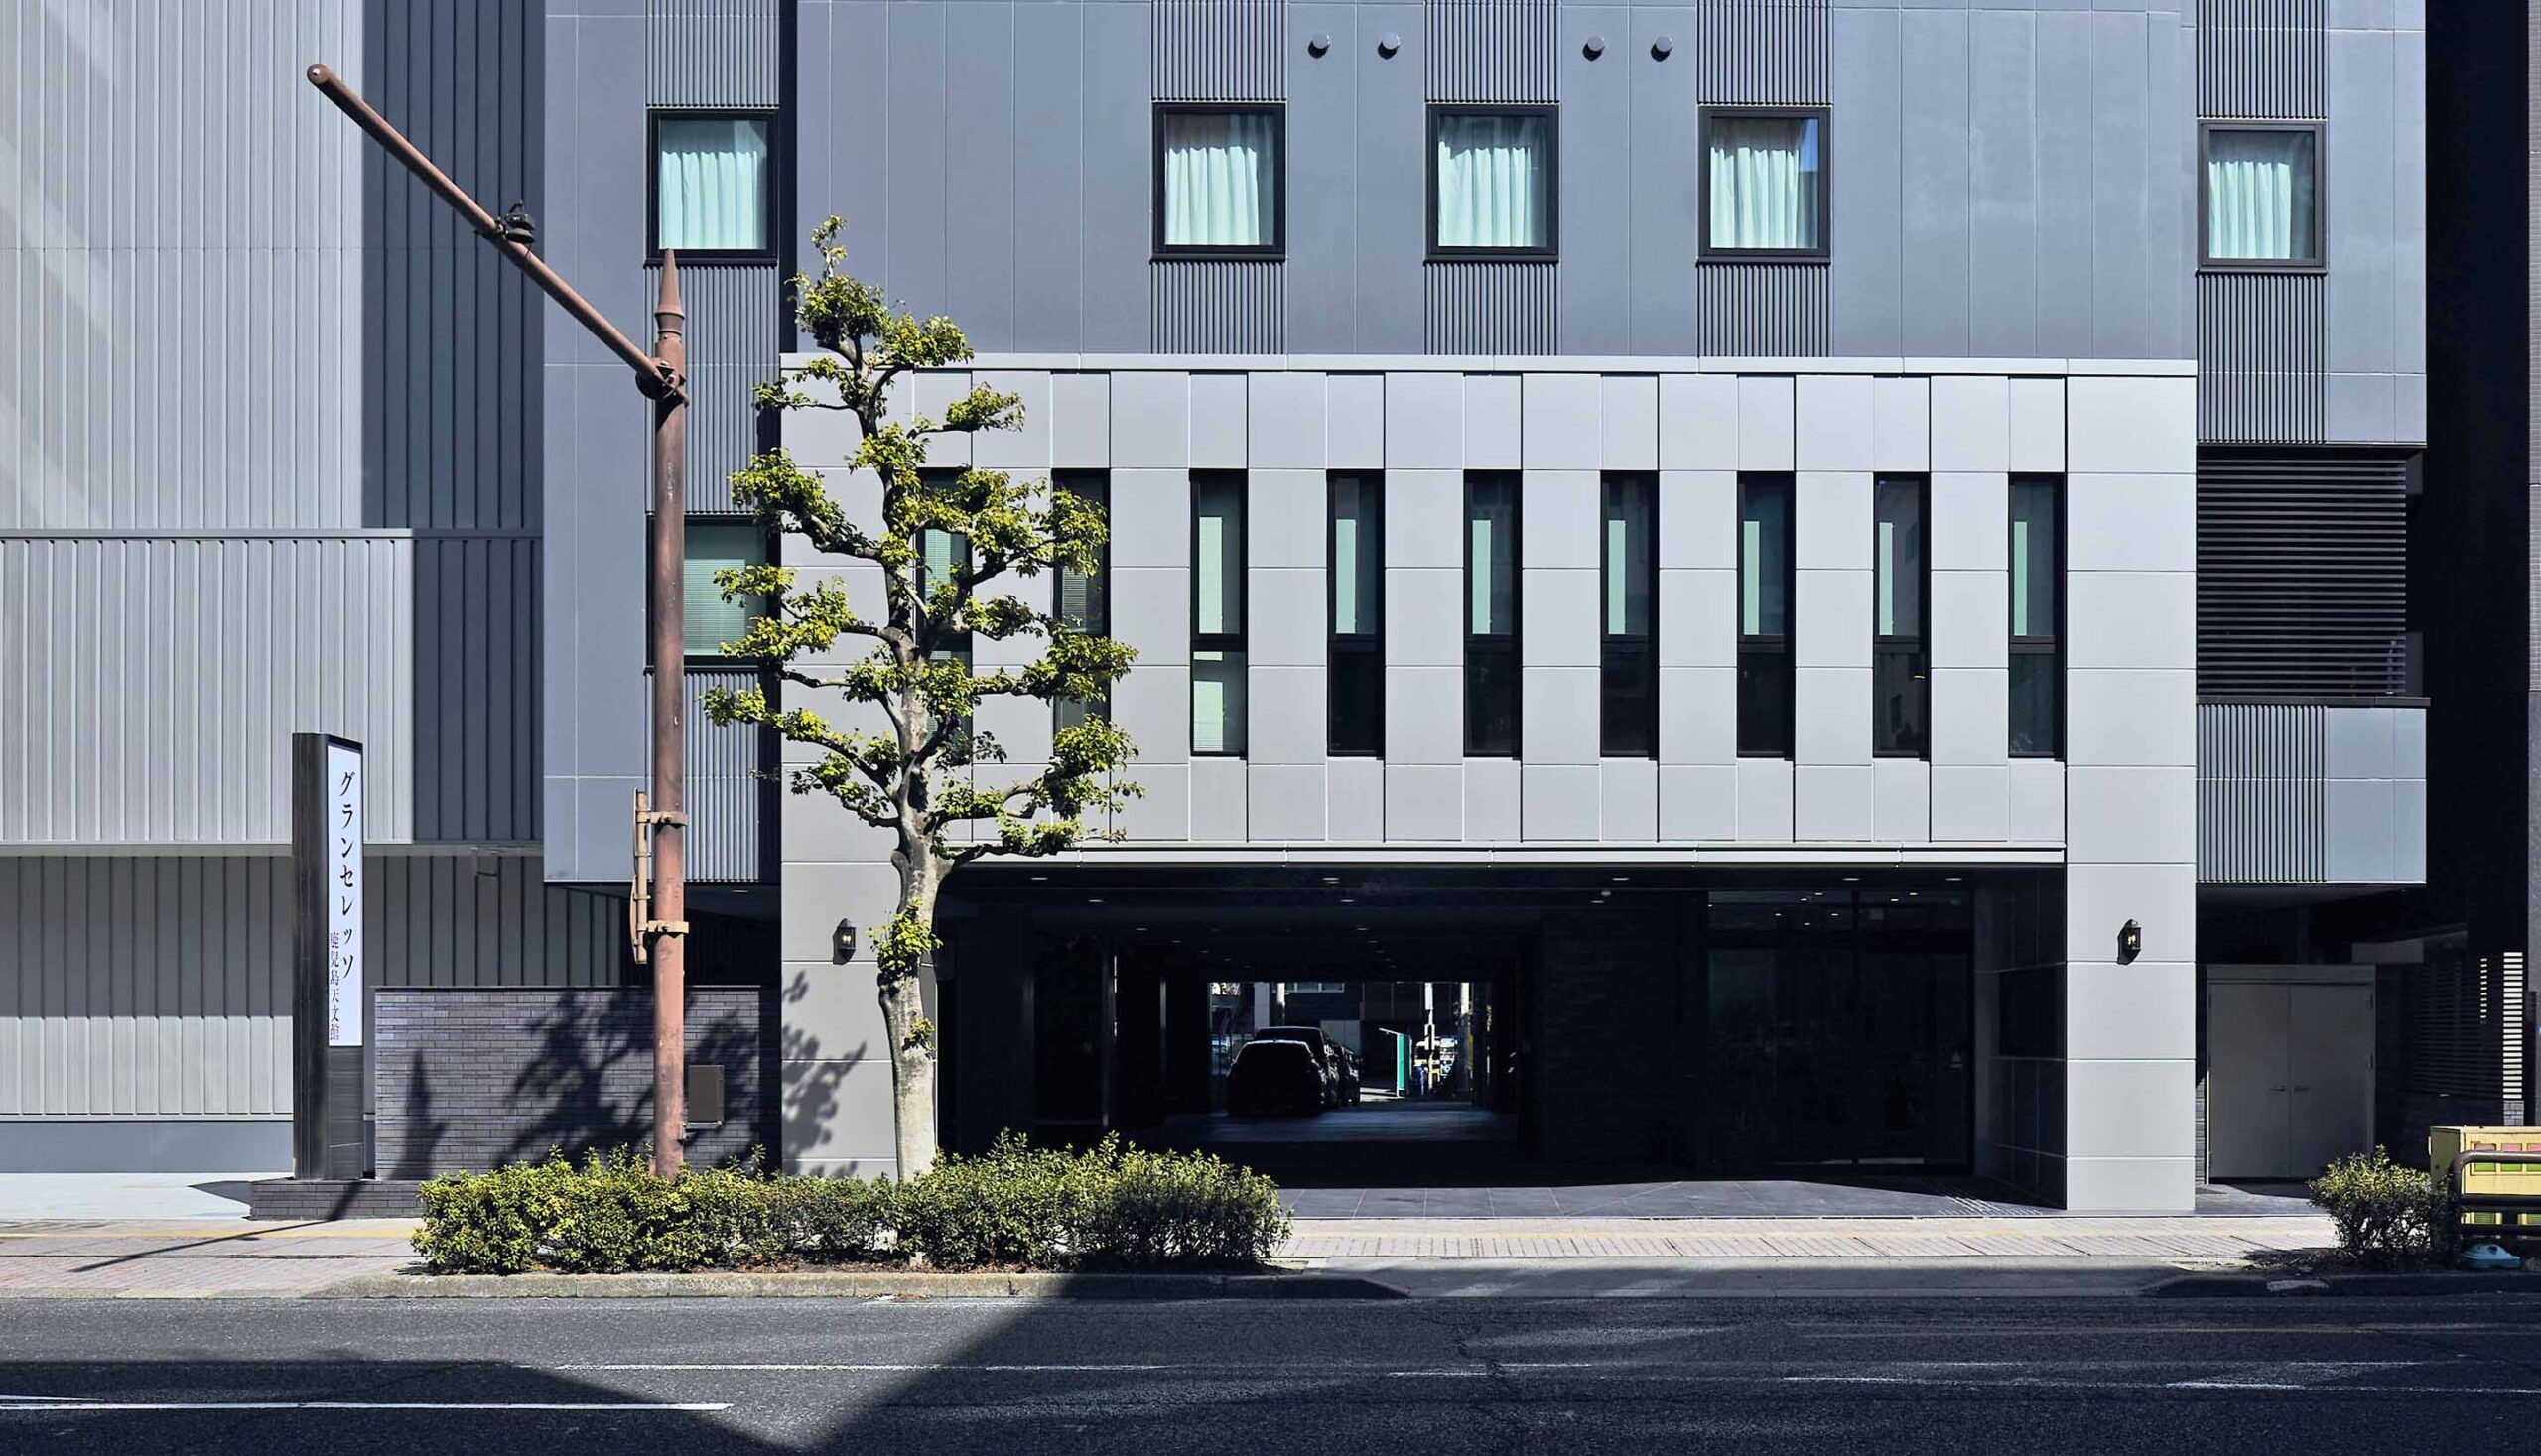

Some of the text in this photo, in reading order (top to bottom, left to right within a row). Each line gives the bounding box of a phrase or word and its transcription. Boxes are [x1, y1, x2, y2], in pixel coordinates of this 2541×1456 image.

[339, 771, 355, 979] グランセレッソ
[330, 931, 339, 1041] 鹿児島天文館
